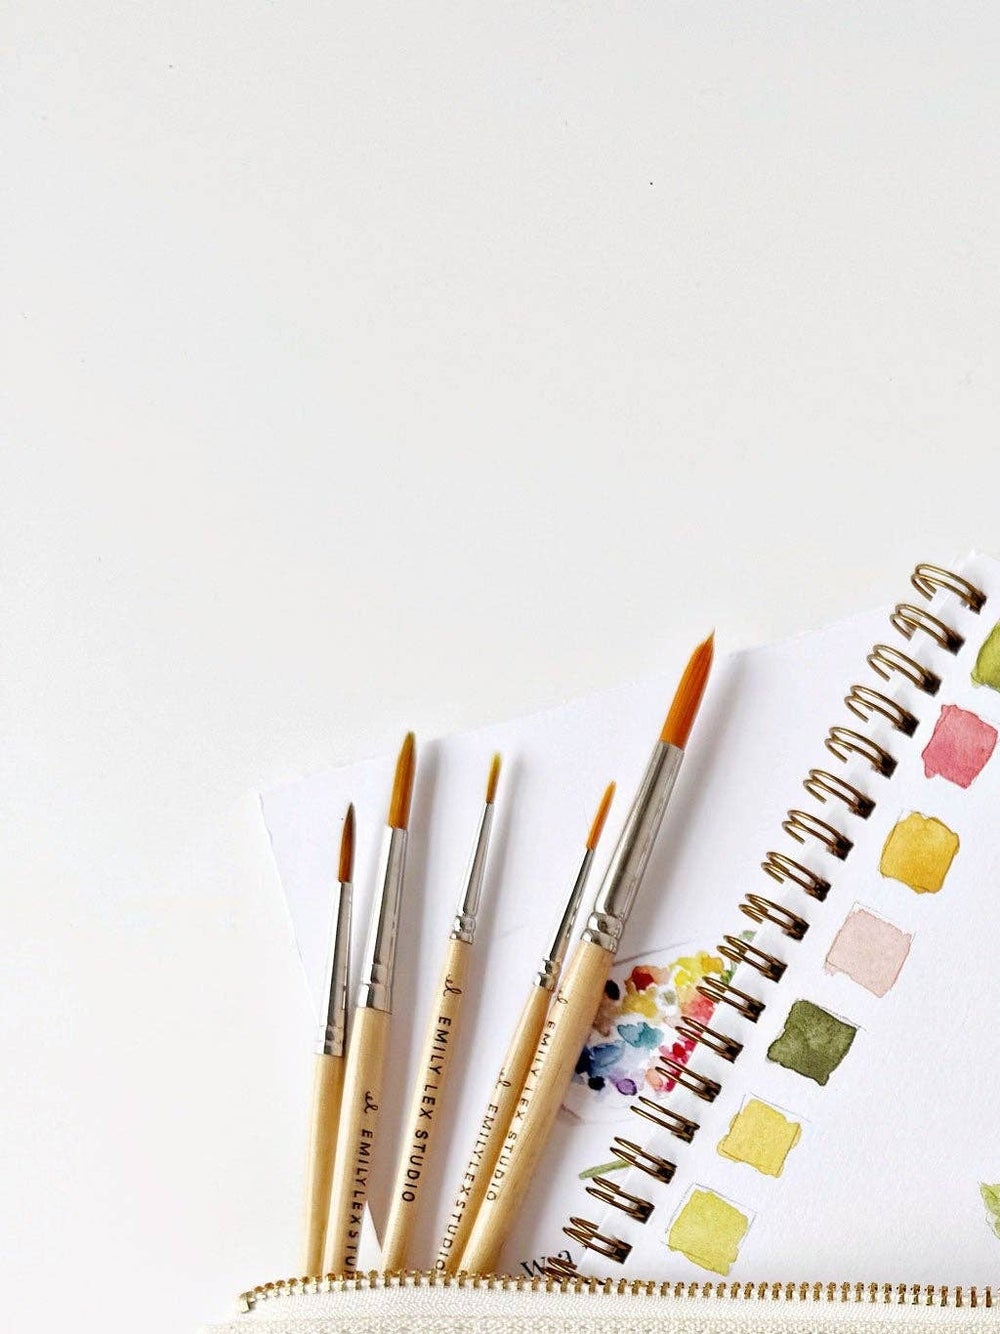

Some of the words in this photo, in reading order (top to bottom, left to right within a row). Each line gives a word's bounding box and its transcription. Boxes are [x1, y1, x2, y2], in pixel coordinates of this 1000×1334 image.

[428, 1015, 452, 1076] EMILY
[530, 1020, 556, 1077] EMILY
[418, 1083, 438, 1120] LEX
[401, 1129, 429, 1203] STUDIO
[486, 1130, 518, 1202] STUDIO
